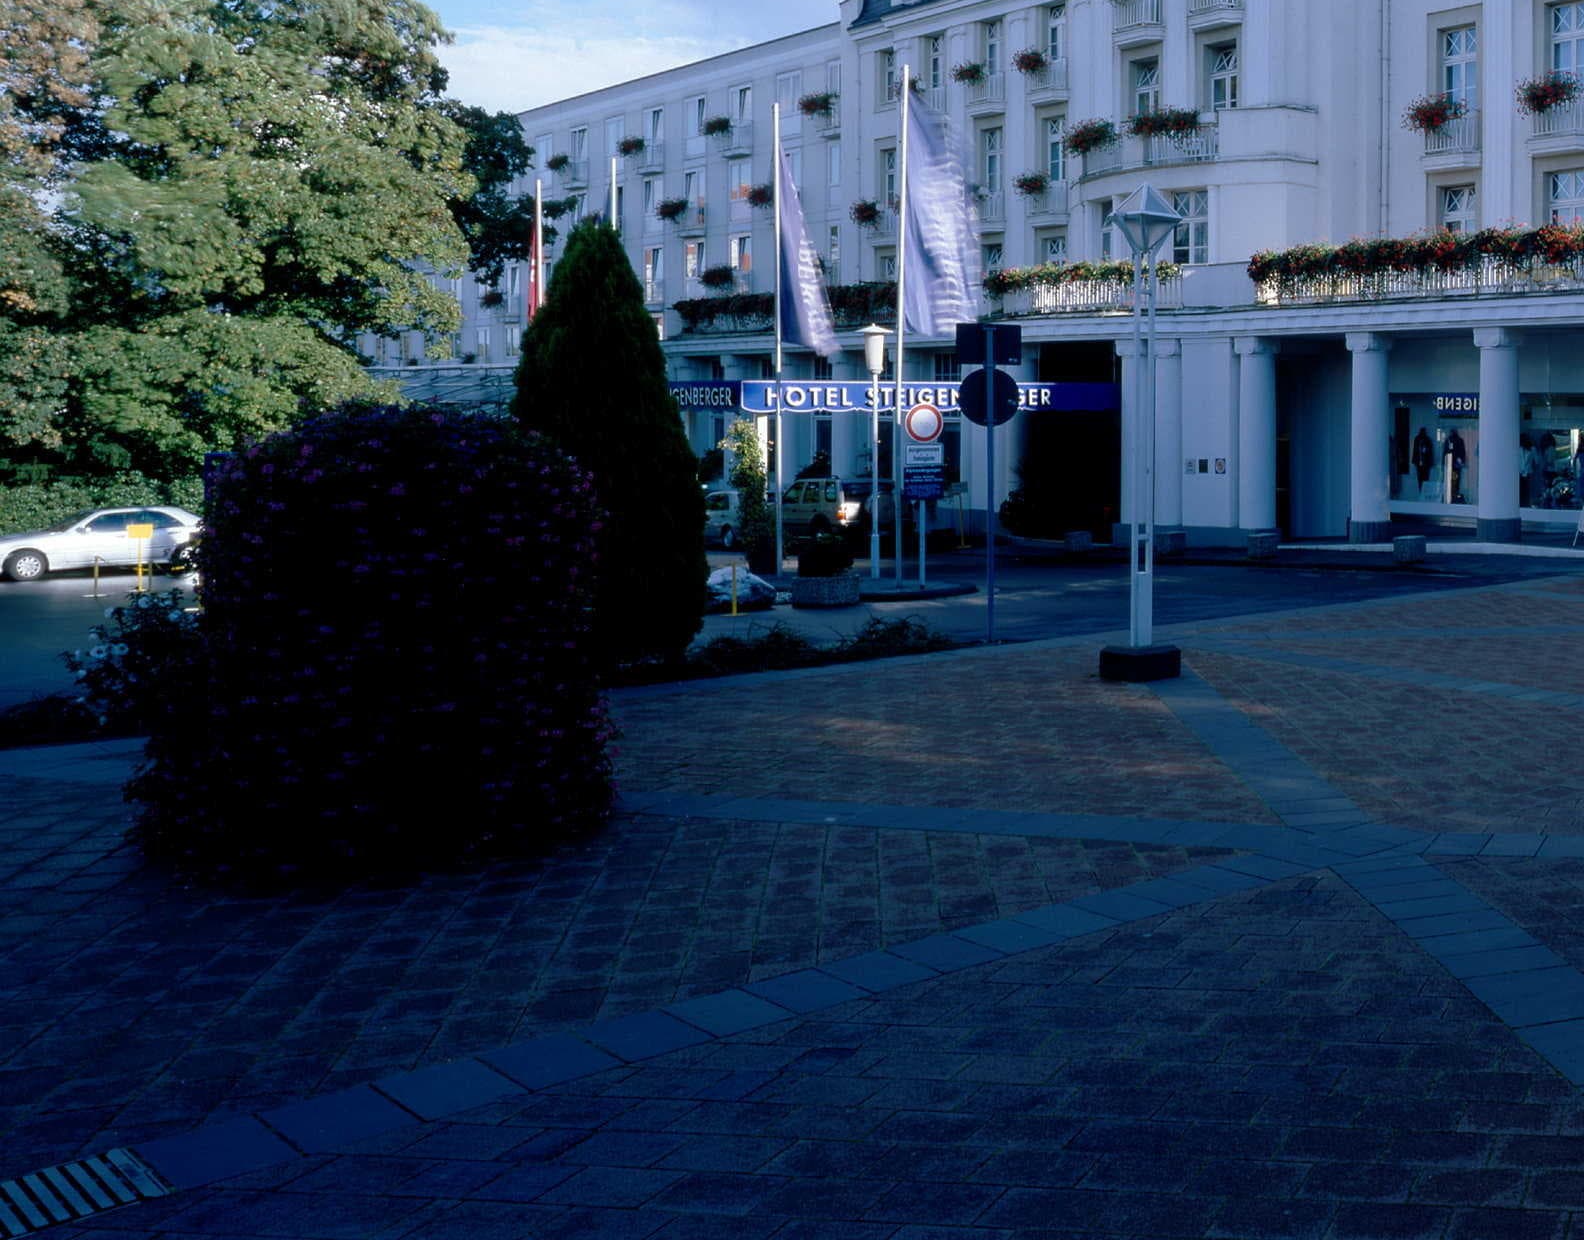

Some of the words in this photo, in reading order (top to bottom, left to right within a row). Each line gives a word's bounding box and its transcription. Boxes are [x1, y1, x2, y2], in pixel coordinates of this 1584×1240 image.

[668, 386, 732, 406] IGENBERGER
[766, 386, 852, 407] HOTEL
[865, 387, 1051, 407] STEIGENGER
